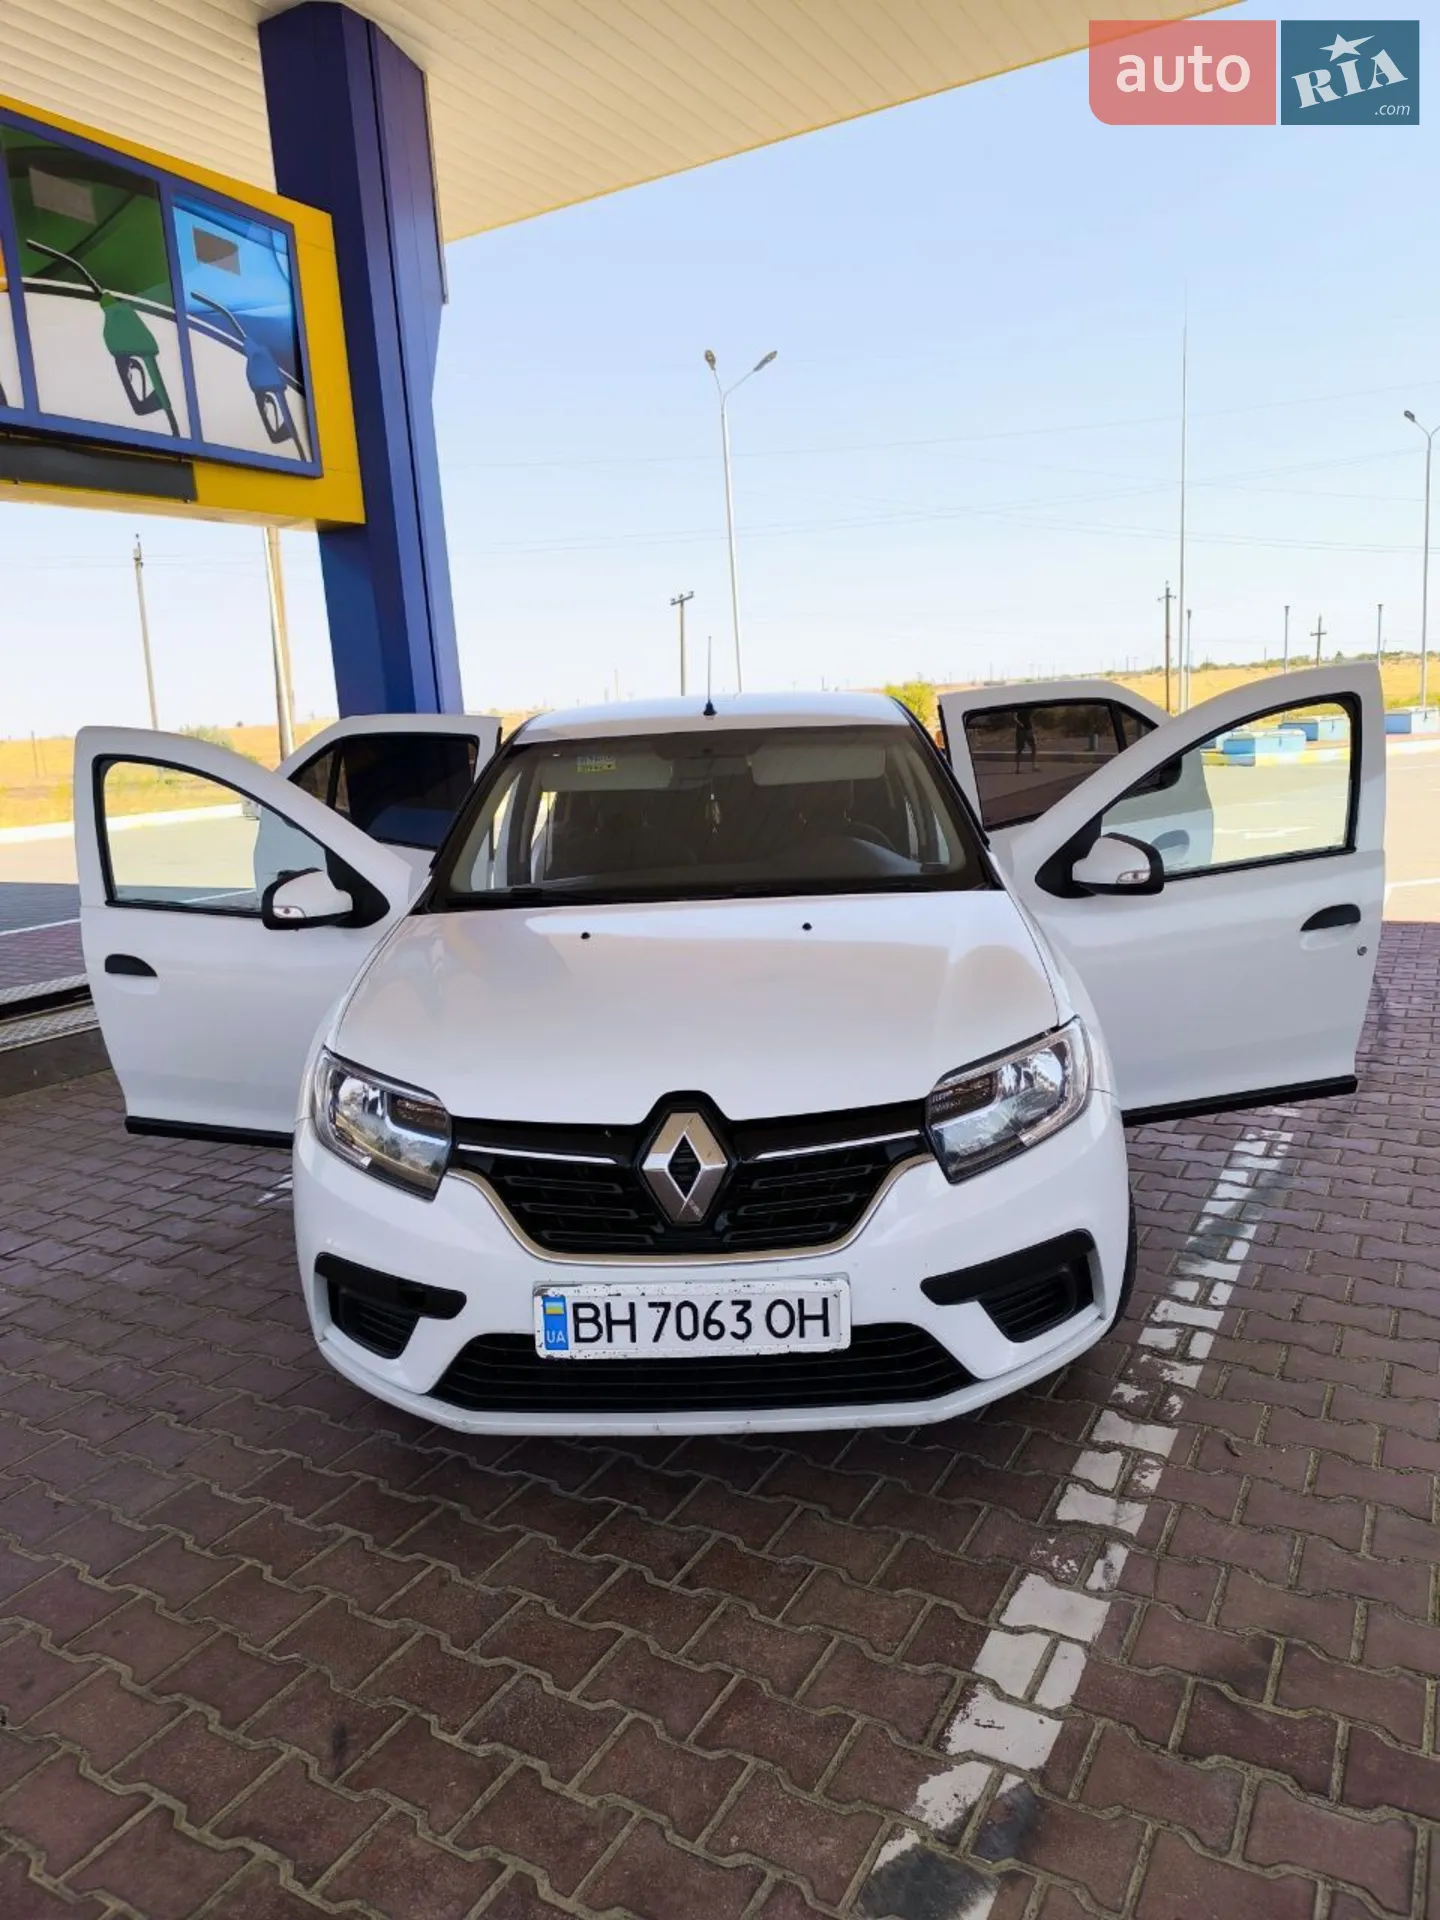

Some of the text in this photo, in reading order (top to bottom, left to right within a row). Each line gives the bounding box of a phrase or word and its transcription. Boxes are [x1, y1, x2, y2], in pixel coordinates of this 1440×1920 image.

[572, 1297, 830, 1344] BH 7063 OH
[546, 1329, 567, 1344] UA
